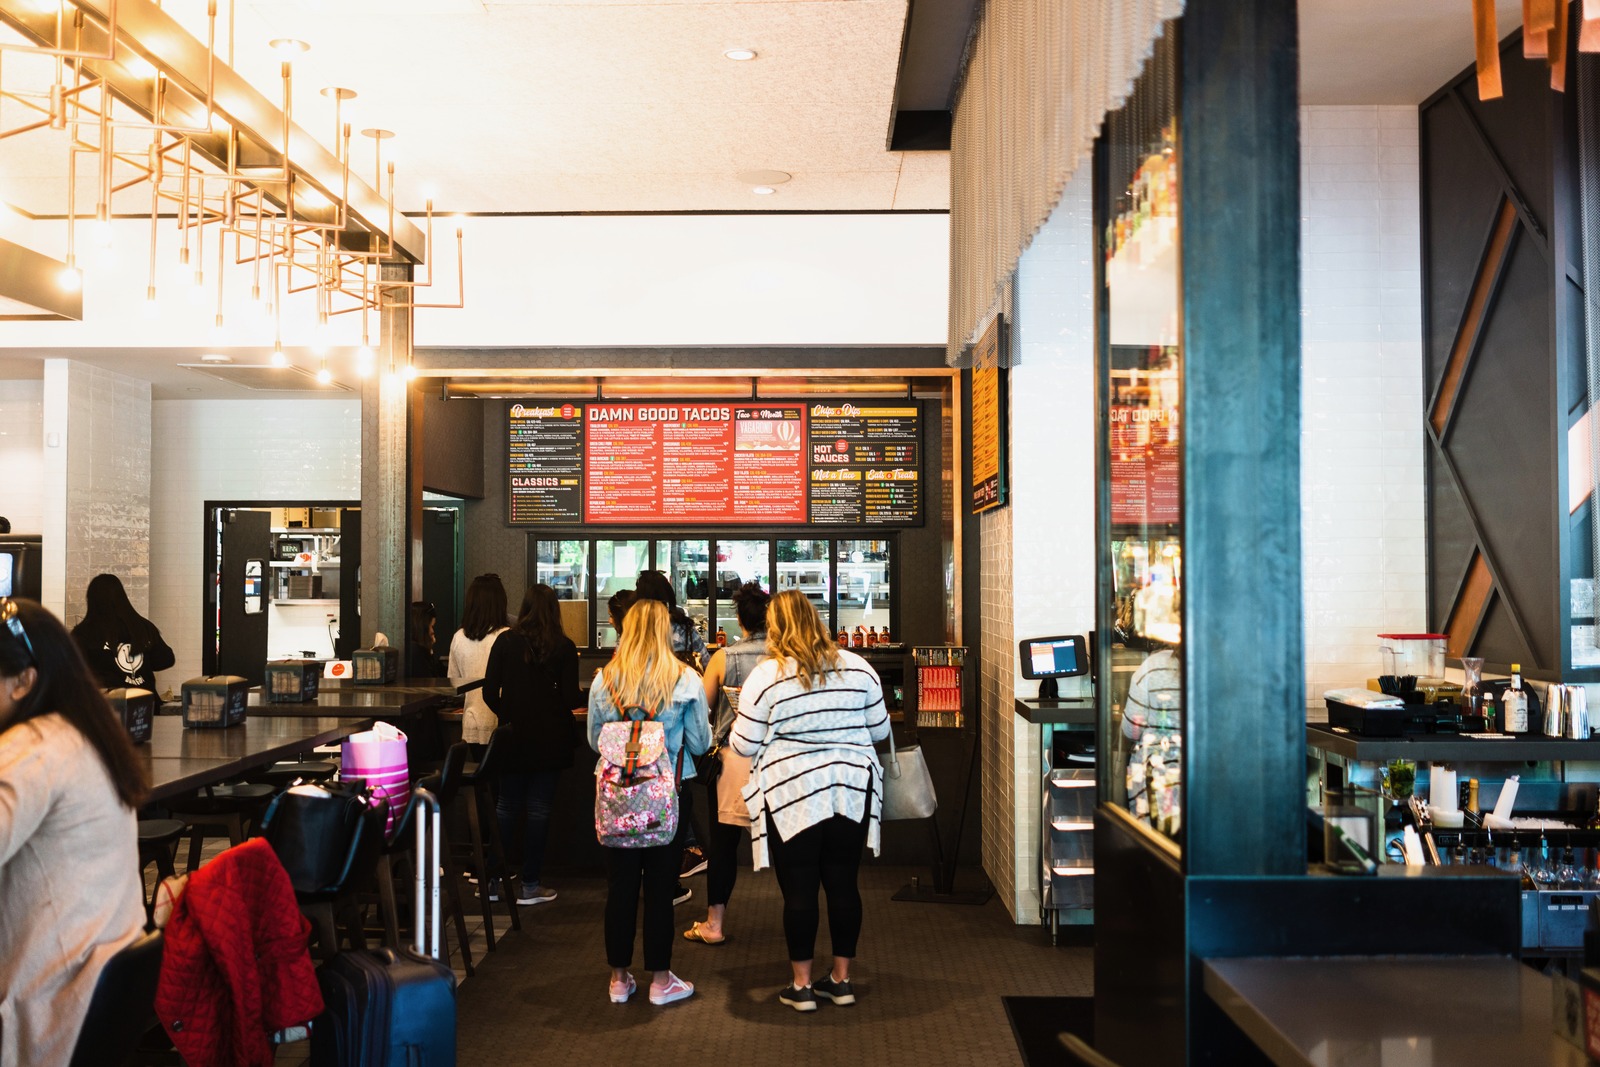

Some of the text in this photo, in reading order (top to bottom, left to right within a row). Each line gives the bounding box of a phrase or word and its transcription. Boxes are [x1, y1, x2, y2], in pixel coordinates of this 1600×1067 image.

[512, 404, 555, 419] Breakfast
[590, 408, 730, 421] DAMN GOOD TACOS
[736, 410, 751, 419] Taco
[760, 410, 783, 419] Month
[814, 404, 835, 418] Chips
[842, 403, 861, 418] Dips
[740, 421, 773, 434] VAGABOND
[814, 445, 832, 453] HOT
[814, 454, 850, 463] SAUCES
[814, 469, 830, 481] Not
[837, 468, 856, 480] Taco
[868, 469, 885, 480] Eats
[892, 468, 914, 480] Treats
[512, 478, 559, 486] CLASSICS
